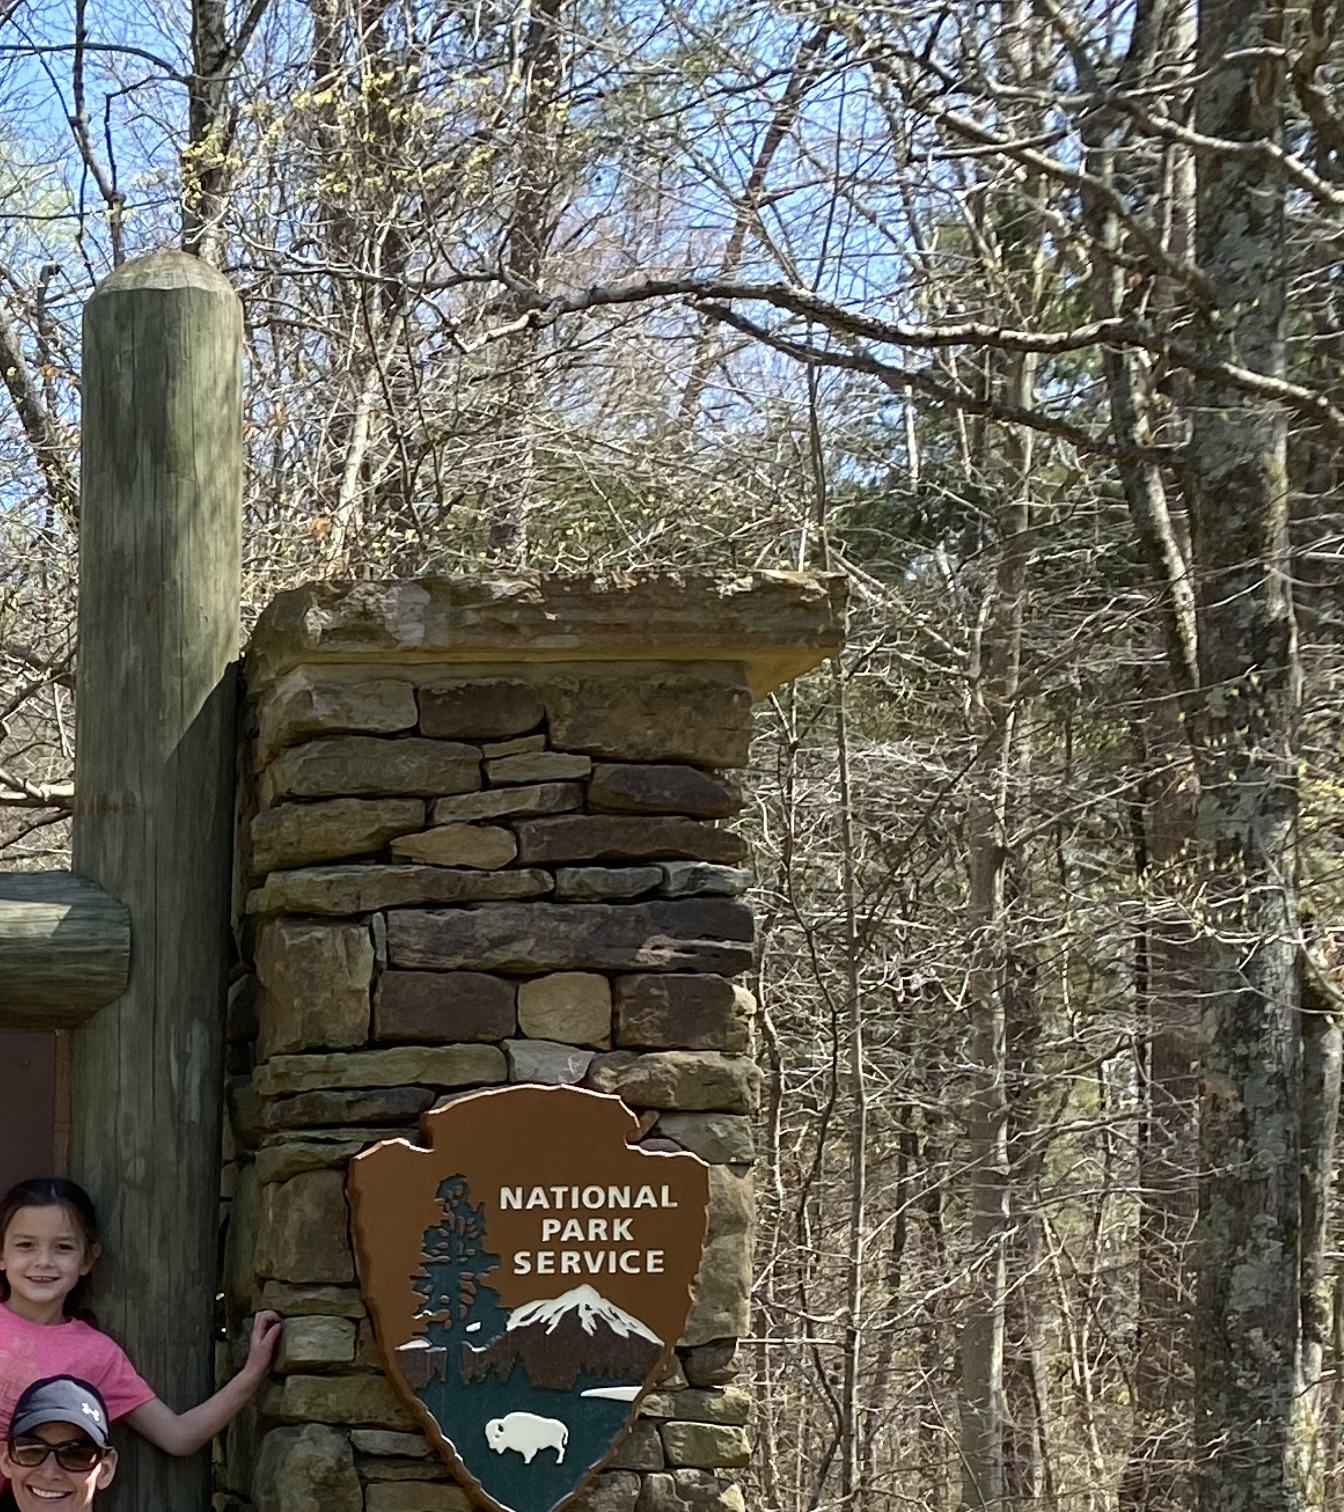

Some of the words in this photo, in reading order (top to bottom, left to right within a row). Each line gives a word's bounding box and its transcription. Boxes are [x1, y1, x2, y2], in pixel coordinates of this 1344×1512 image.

[500, 1185, 678, 1210] NATIONAL
[542, 1218, 634, 1242] PARK
[513, 1250, 665, 1275] SERVICE
